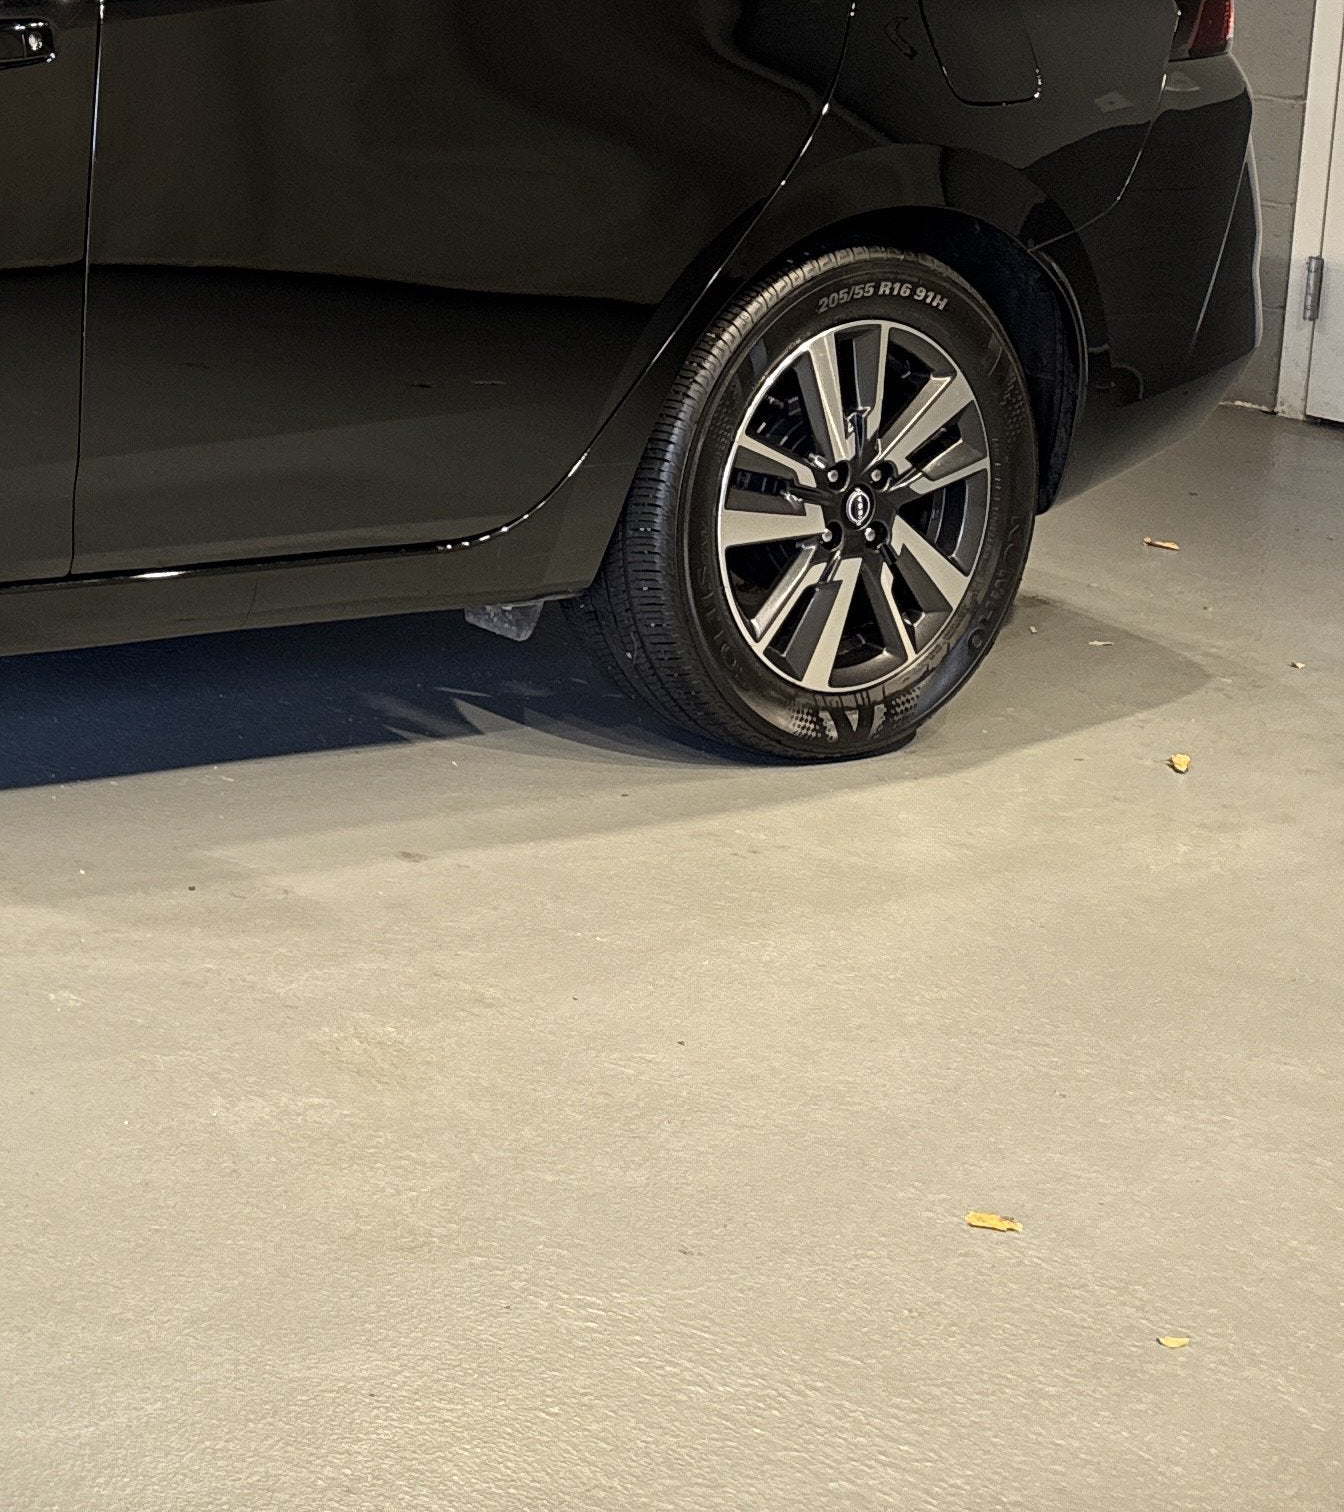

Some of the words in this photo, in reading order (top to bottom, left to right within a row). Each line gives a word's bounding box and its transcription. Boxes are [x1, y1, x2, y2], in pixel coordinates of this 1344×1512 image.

[816, 282, 875, 314] 205/55
[877, 280, 912, 297] R16
[913, 286, 949, 310] 91H
